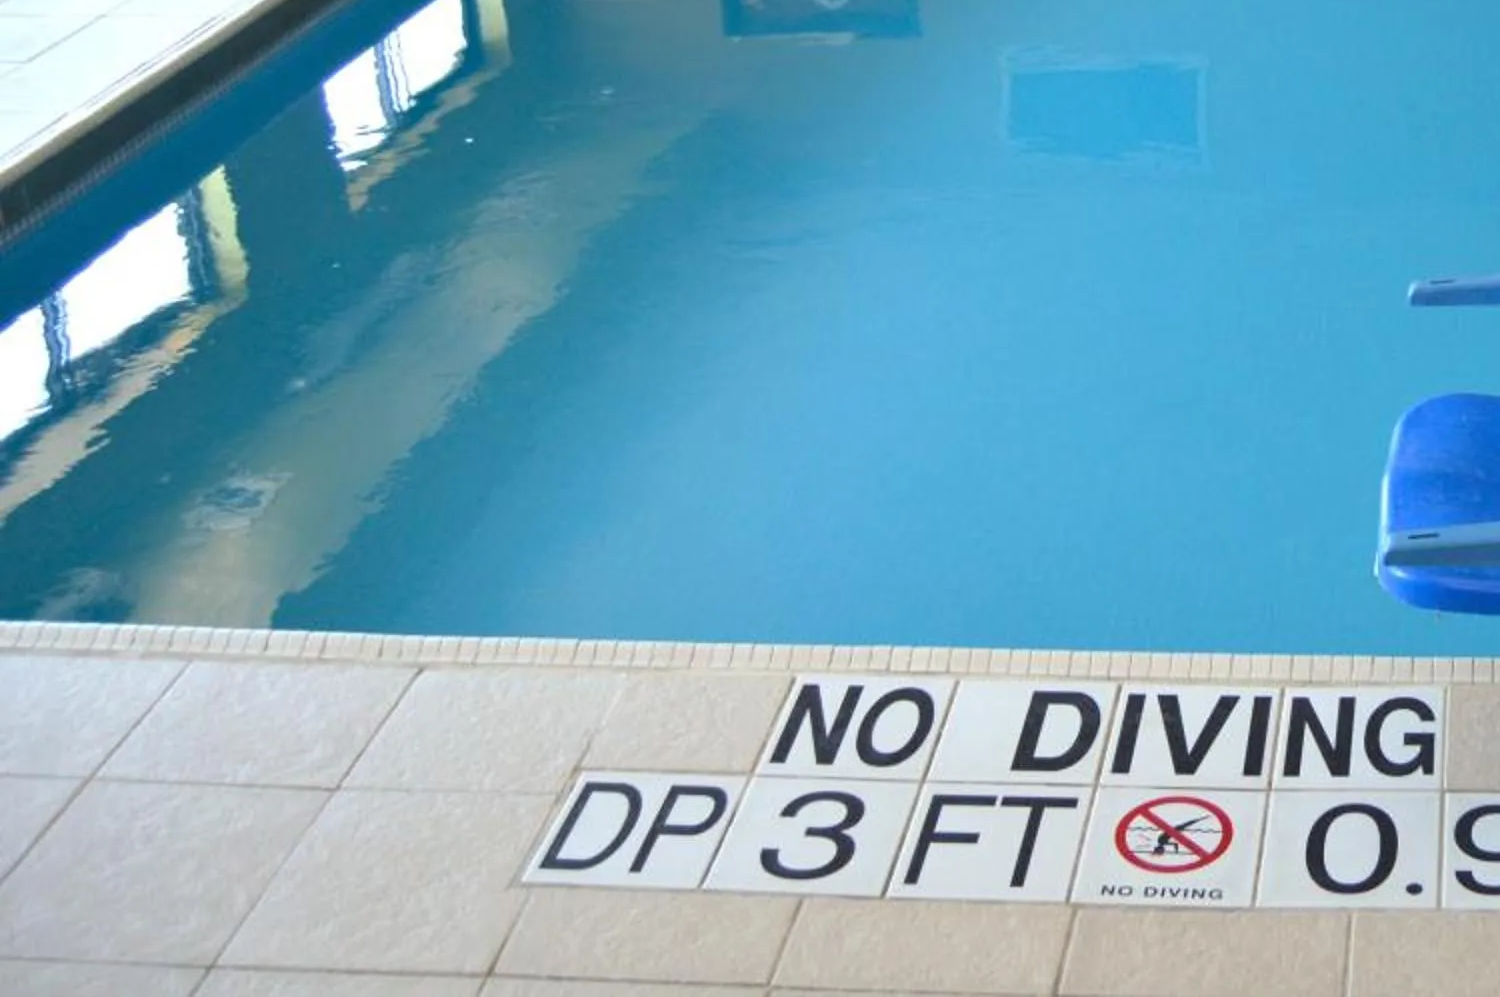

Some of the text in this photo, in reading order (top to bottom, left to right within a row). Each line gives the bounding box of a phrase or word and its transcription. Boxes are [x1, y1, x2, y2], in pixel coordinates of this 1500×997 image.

[769, 684, 1436, 777] NO DIVING
[538, 781, 728, 873] DP
[760, 791, 866, 880] 3
[903, 794, 1079, 888] FT
[1100, 884, 1224, 901] NO DIVING
